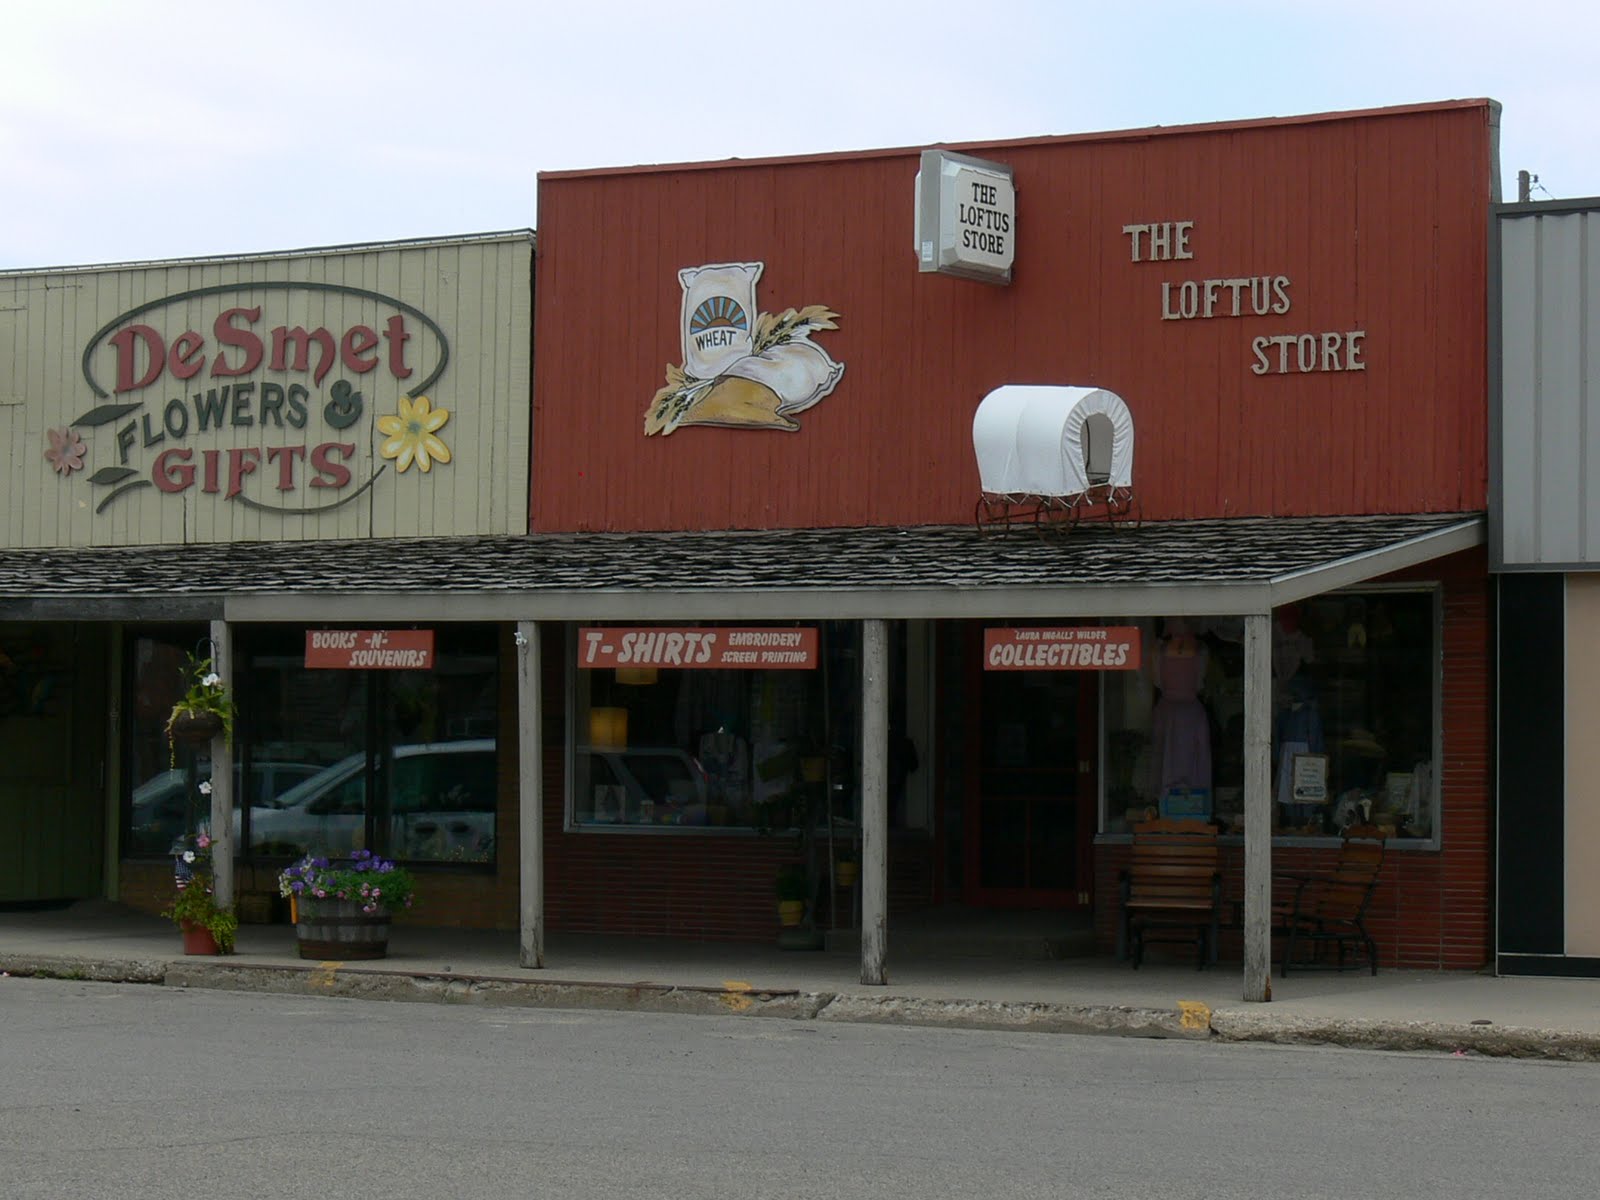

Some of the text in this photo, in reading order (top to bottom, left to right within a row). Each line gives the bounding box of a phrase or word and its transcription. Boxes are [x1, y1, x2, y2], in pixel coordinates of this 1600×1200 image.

[971, 182, 998, 206] THE
[959, 203, 1010, 233] LOFTUS
[962, 229, 1005, 255] STORE
[1122, 220, 1194, 262] THE
[1160, 275, 1291, 320] LOFTUS
[695, 330, 737, 352] WHEAT
[1250, 330, 1366, 375] STORE
[116, 379, 364, 465] FLOWERS &
[151, 442, 356, 501] GIFTS
[311, 631, 358, 649] BOOKS
[728, 632, 802, 647] EMBROIDERY
[1015, 630, 1108, 641] LAURA INGALLS WILDER
[348, 649, 427, 667] SOUVENIRS
[720, 651, 808, 663] SCREEN PRINTING
[988, 643, 1130, 667] COLLECTIBLES
